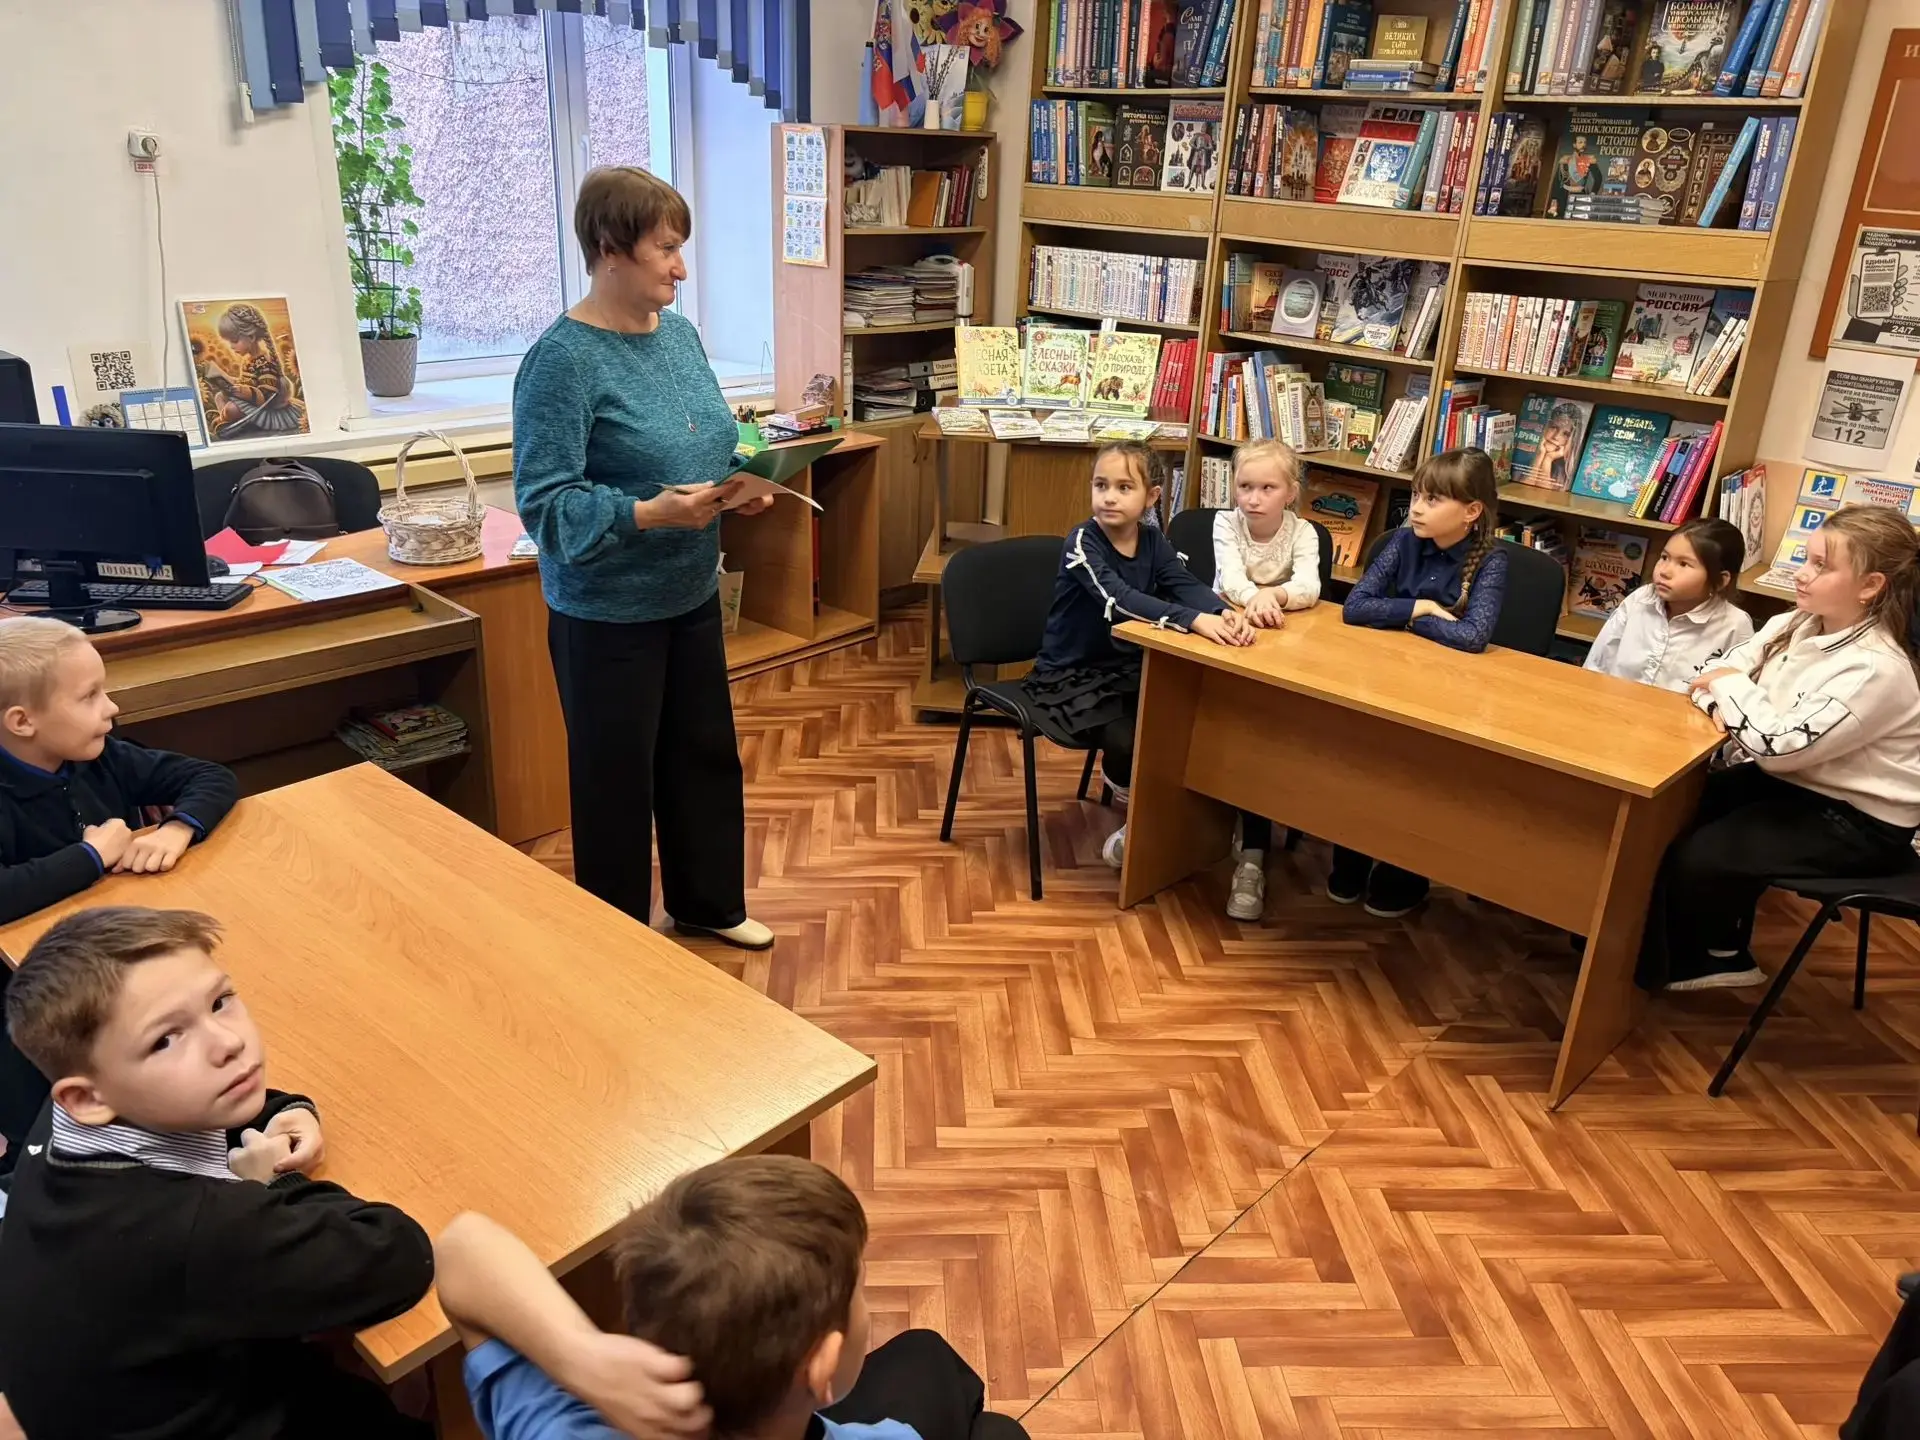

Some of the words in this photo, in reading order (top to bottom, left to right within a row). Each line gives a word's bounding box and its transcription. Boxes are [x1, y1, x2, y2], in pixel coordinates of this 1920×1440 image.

[1670, 2, 1720, 10] БОЛЬШАЯ
[1385, 32, 1417, 40] ВЕЛИКИХ
[1570, 125, 1640, 135] ЭНЦИКЛОПЕДИЯ
[1596, 136, 1638, 146] ИСТОРИИ
[1600, 146, 1636, 156] РОССИИ
[1646, 300, 1699, 313] РОССИЯ
[1891, 325, 1914, 335] 24/7
[972, 348, 1008, 361] ЕСНАЯ
[1038, 348, 1078, 360] ЛЕСНЫЕ
[1108, 352, 1145, 363] РАССКАЗЫ
[974, 364, 1008, 376] АЗЕТА
[1039, 362, 1076, 373] СКАЗКИ
[1111, 365, 1147, 376] ПРИРОДЕ
[1829, 379, 1874, 389] ПОДОЗРИТЕЛЬНЫЙ
[1859, 376, 1895, 386] ОБНАРУЖИЛИ
[1608, 414, 1623, 424] ЧТО
[1623, 417, 1656, 431] ДЕЛАТЬ,
[1614, 429, 1642, 442] ЕСЛИ...
[1834, 426, 1866, 444] 112
[1871, 496, 1900, 505] СЕРВИСА
